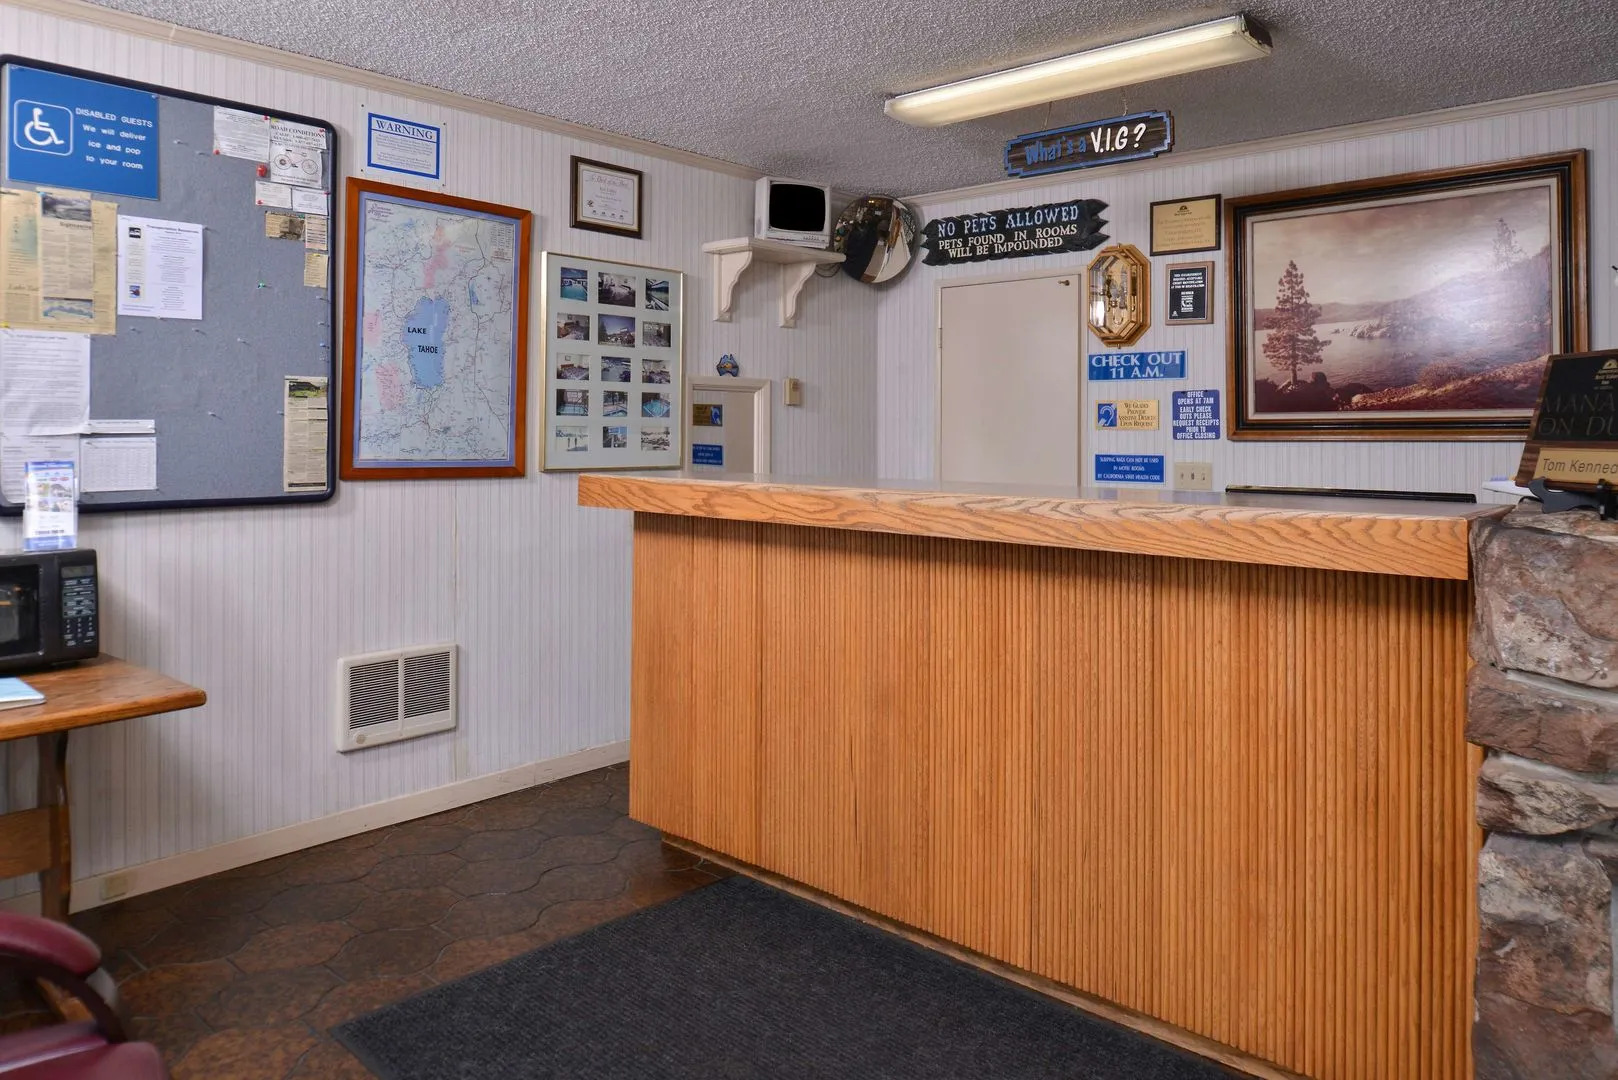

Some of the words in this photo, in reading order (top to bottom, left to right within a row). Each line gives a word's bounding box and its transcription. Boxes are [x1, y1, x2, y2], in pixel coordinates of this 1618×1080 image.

[75, 107, 117, 121] DISABLED
[120, 116, 153, 128] GUESTS
[82, 124, 96, 133] We
[100, 128, 115, 136] will
[119, 131, 146, 141] deliver
[288, 127, 325, 138] CONDITIONS
[376, 119, 433, 140] WARNING
[106, 143, 121, 152] and
[125, 147, 141, 156] pop
[1024, 135, 1073, 166] What's
[1078, 136, 1087, 153] a
[122, 161, 143, 170] room
[938, 221, 956, 238] NO
[963, 216, 997, 235] PETS
[1005, 205, 1079, 229] ALLOWED
[938, 238, 963, 250] PETS
[968, 234, 1005, 247] FOUND
[1014, 230, 1027, 241] IN
[1036, 224, 1077, 239] ROOMS
[948, 247, 972, 259] WILL
[976, 245, 989, 256] BE
[994, 237, 1063, 254] IMPOUNDED
[407, 326, 427, 335] LAKE
[417, 345, 439, 354] TAHOE
[1091, 354, 1140, 368] CHECK
[1147, 352, 1183, 366] OUT
[1110, 367, 1124, 379] 11
[1130, 366, 1164, 378] A.M.
[1538, 415, 1575, 436] ON
[1542, 457, 1566, 472] Tom
